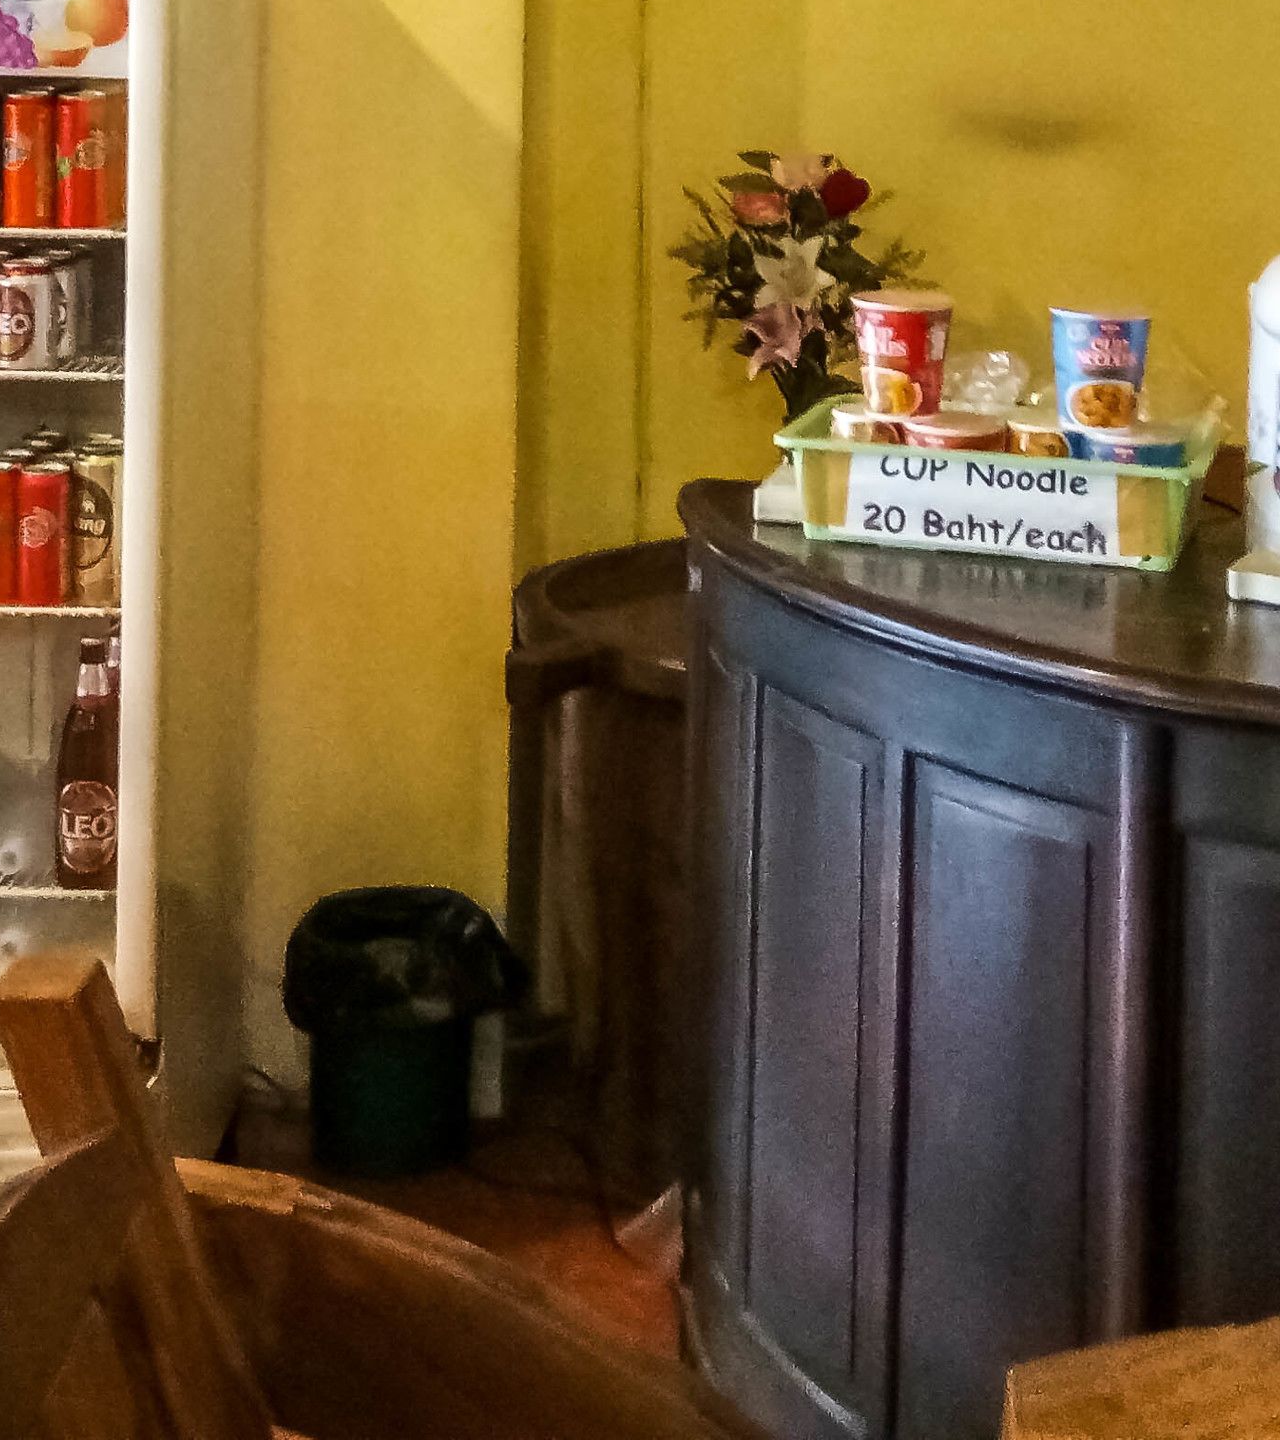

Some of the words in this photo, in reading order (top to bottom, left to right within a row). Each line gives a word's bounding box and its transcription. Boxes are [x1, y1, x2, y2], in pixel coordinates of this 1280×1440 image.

[966, 461, 1089, 496] Noodle
[862, 503, 907, 535] 20
[923, 509, 1108, 556] Baht/each
[61, 812, 116, 839] LEO
